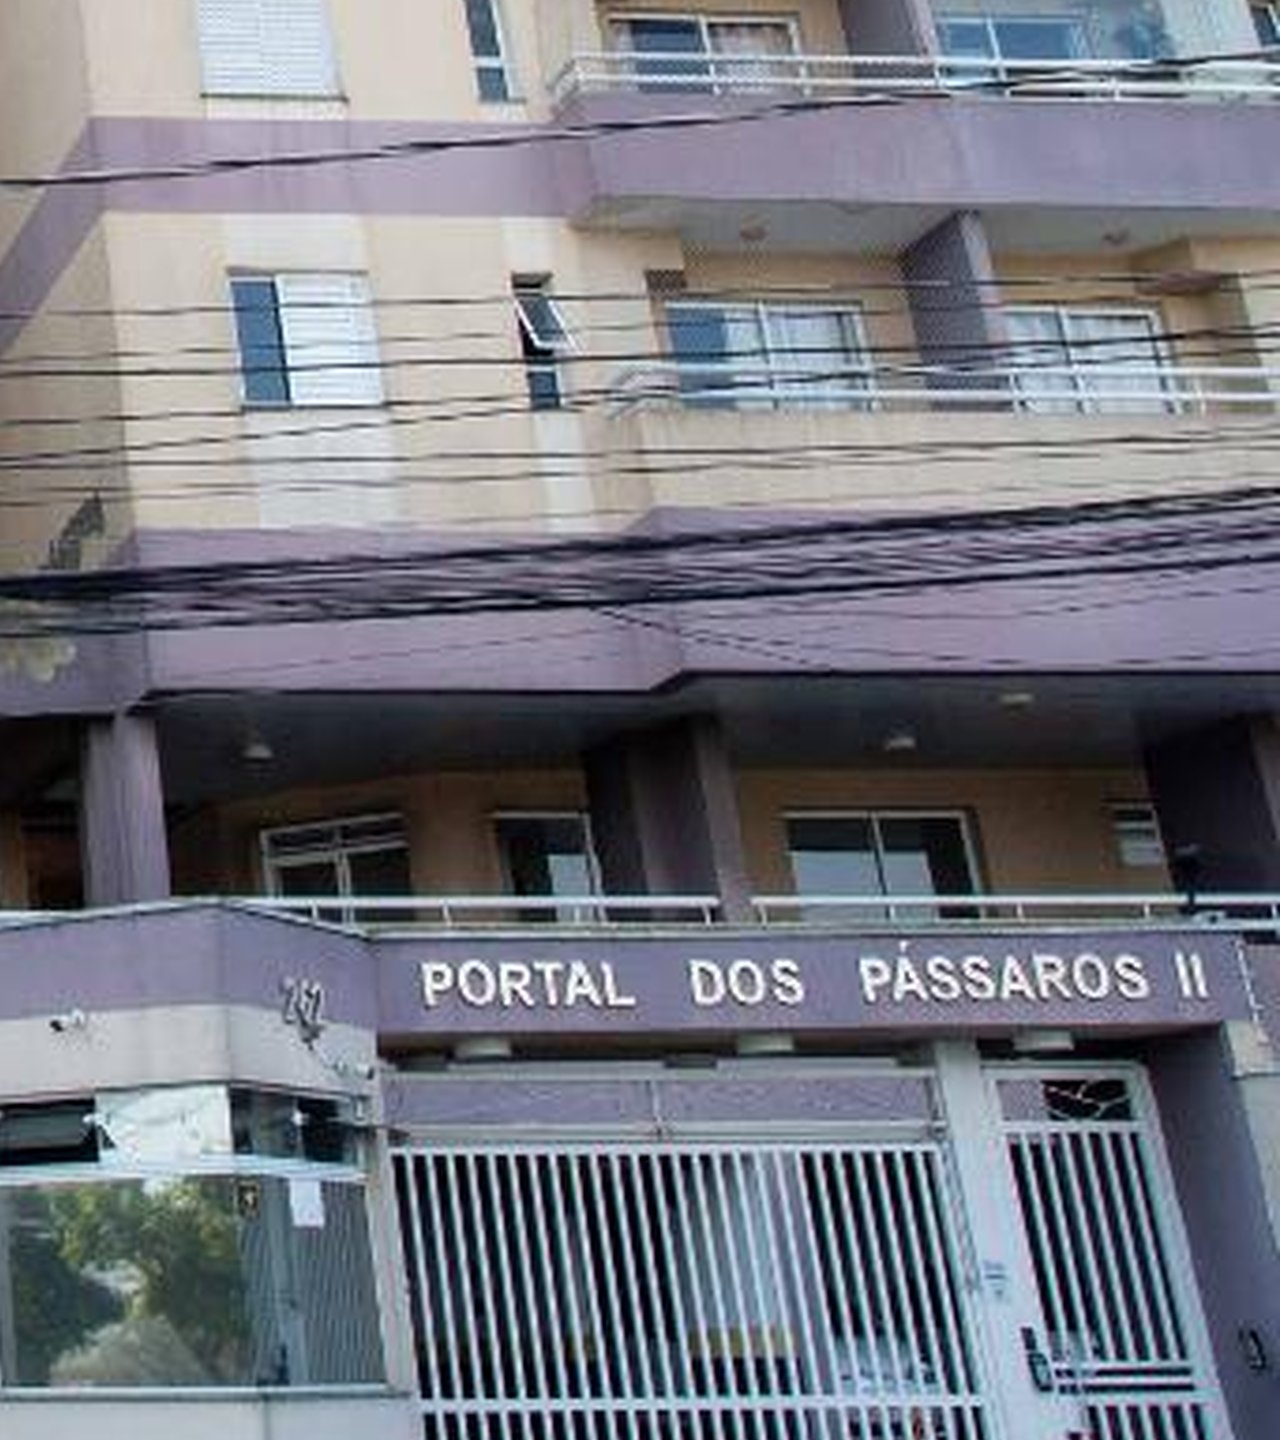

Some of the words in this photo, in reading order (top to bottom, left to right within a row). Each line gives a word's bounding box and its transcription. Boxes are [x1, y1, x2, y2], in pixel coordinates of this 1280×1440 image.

[420, 958, 636, 1008] PORTAL
[689, 957, 806, 1006] DOS
[858, 940, 1151, 1003] PÁSSAROS
[1176, 954, 1211, 998] II
